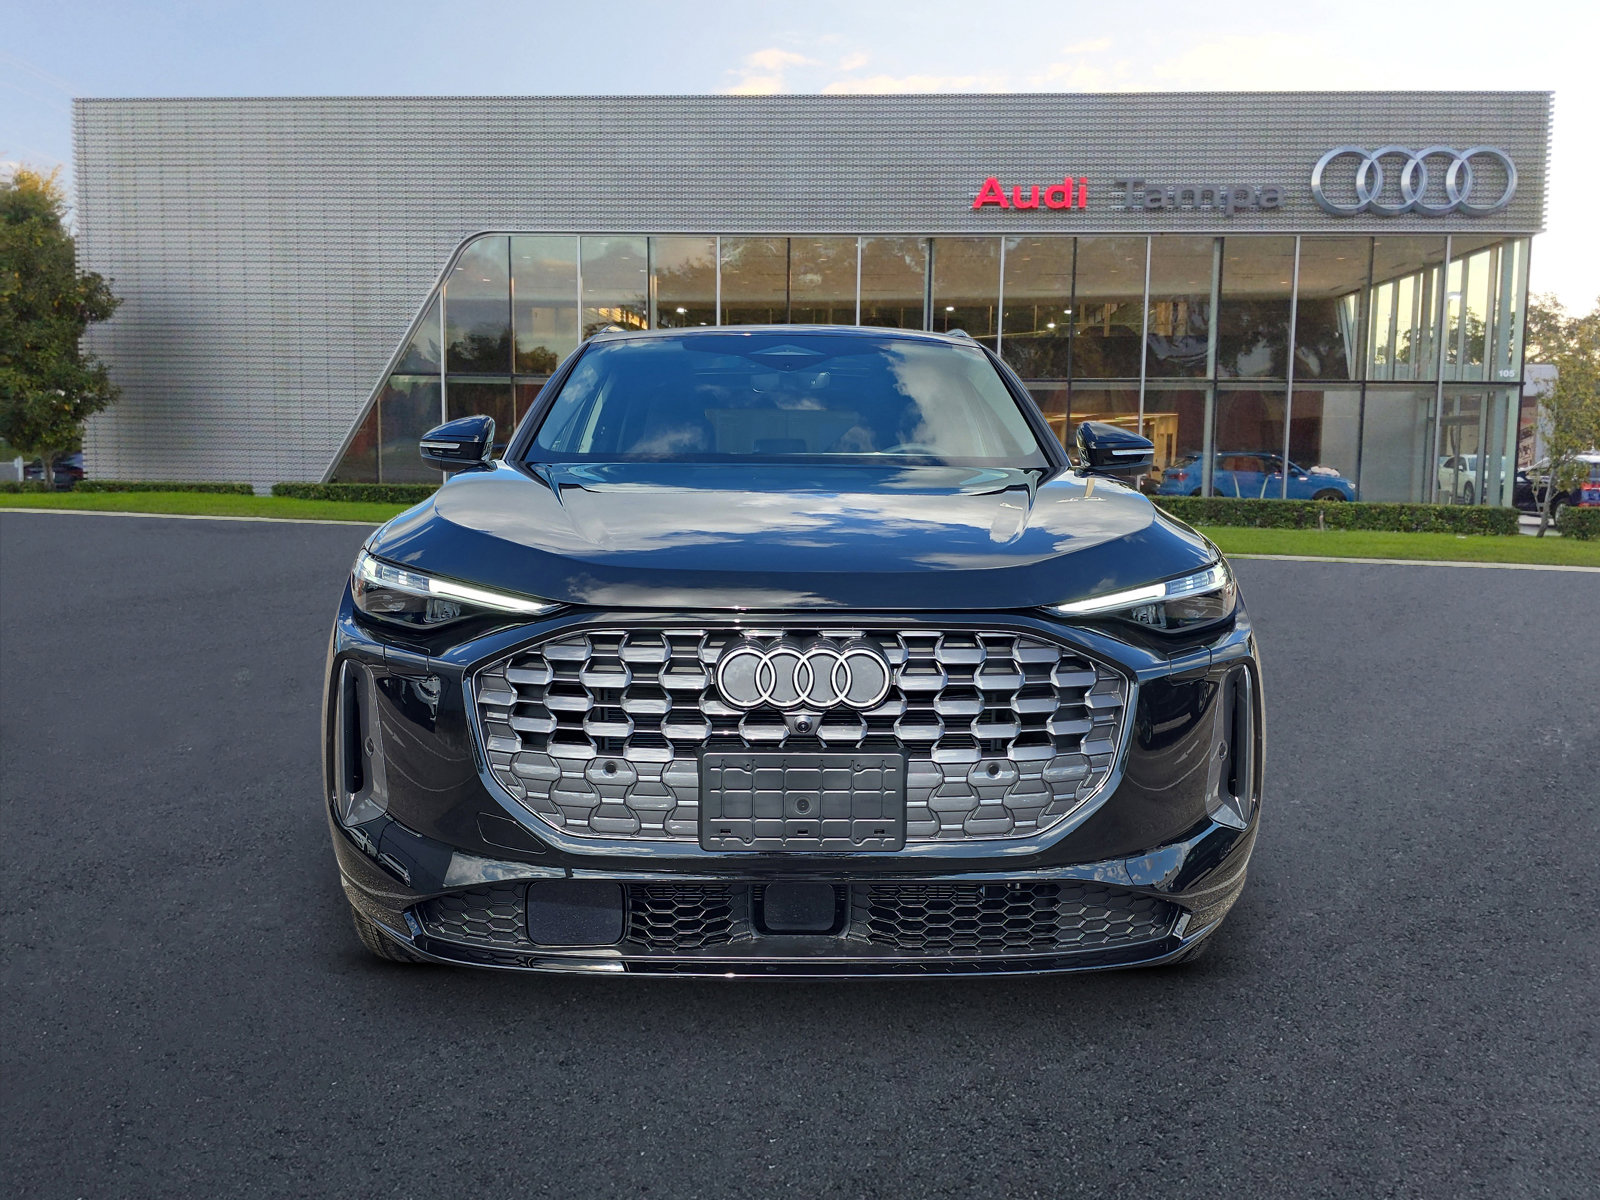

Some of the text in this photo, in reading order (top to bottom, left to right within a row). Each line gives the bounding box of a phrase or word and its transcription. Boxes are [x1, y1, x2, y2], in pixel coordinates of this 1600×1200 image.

[972, 176, 1286, 218] Audi Tampa
[1499, 369, 1515, 378] 105
